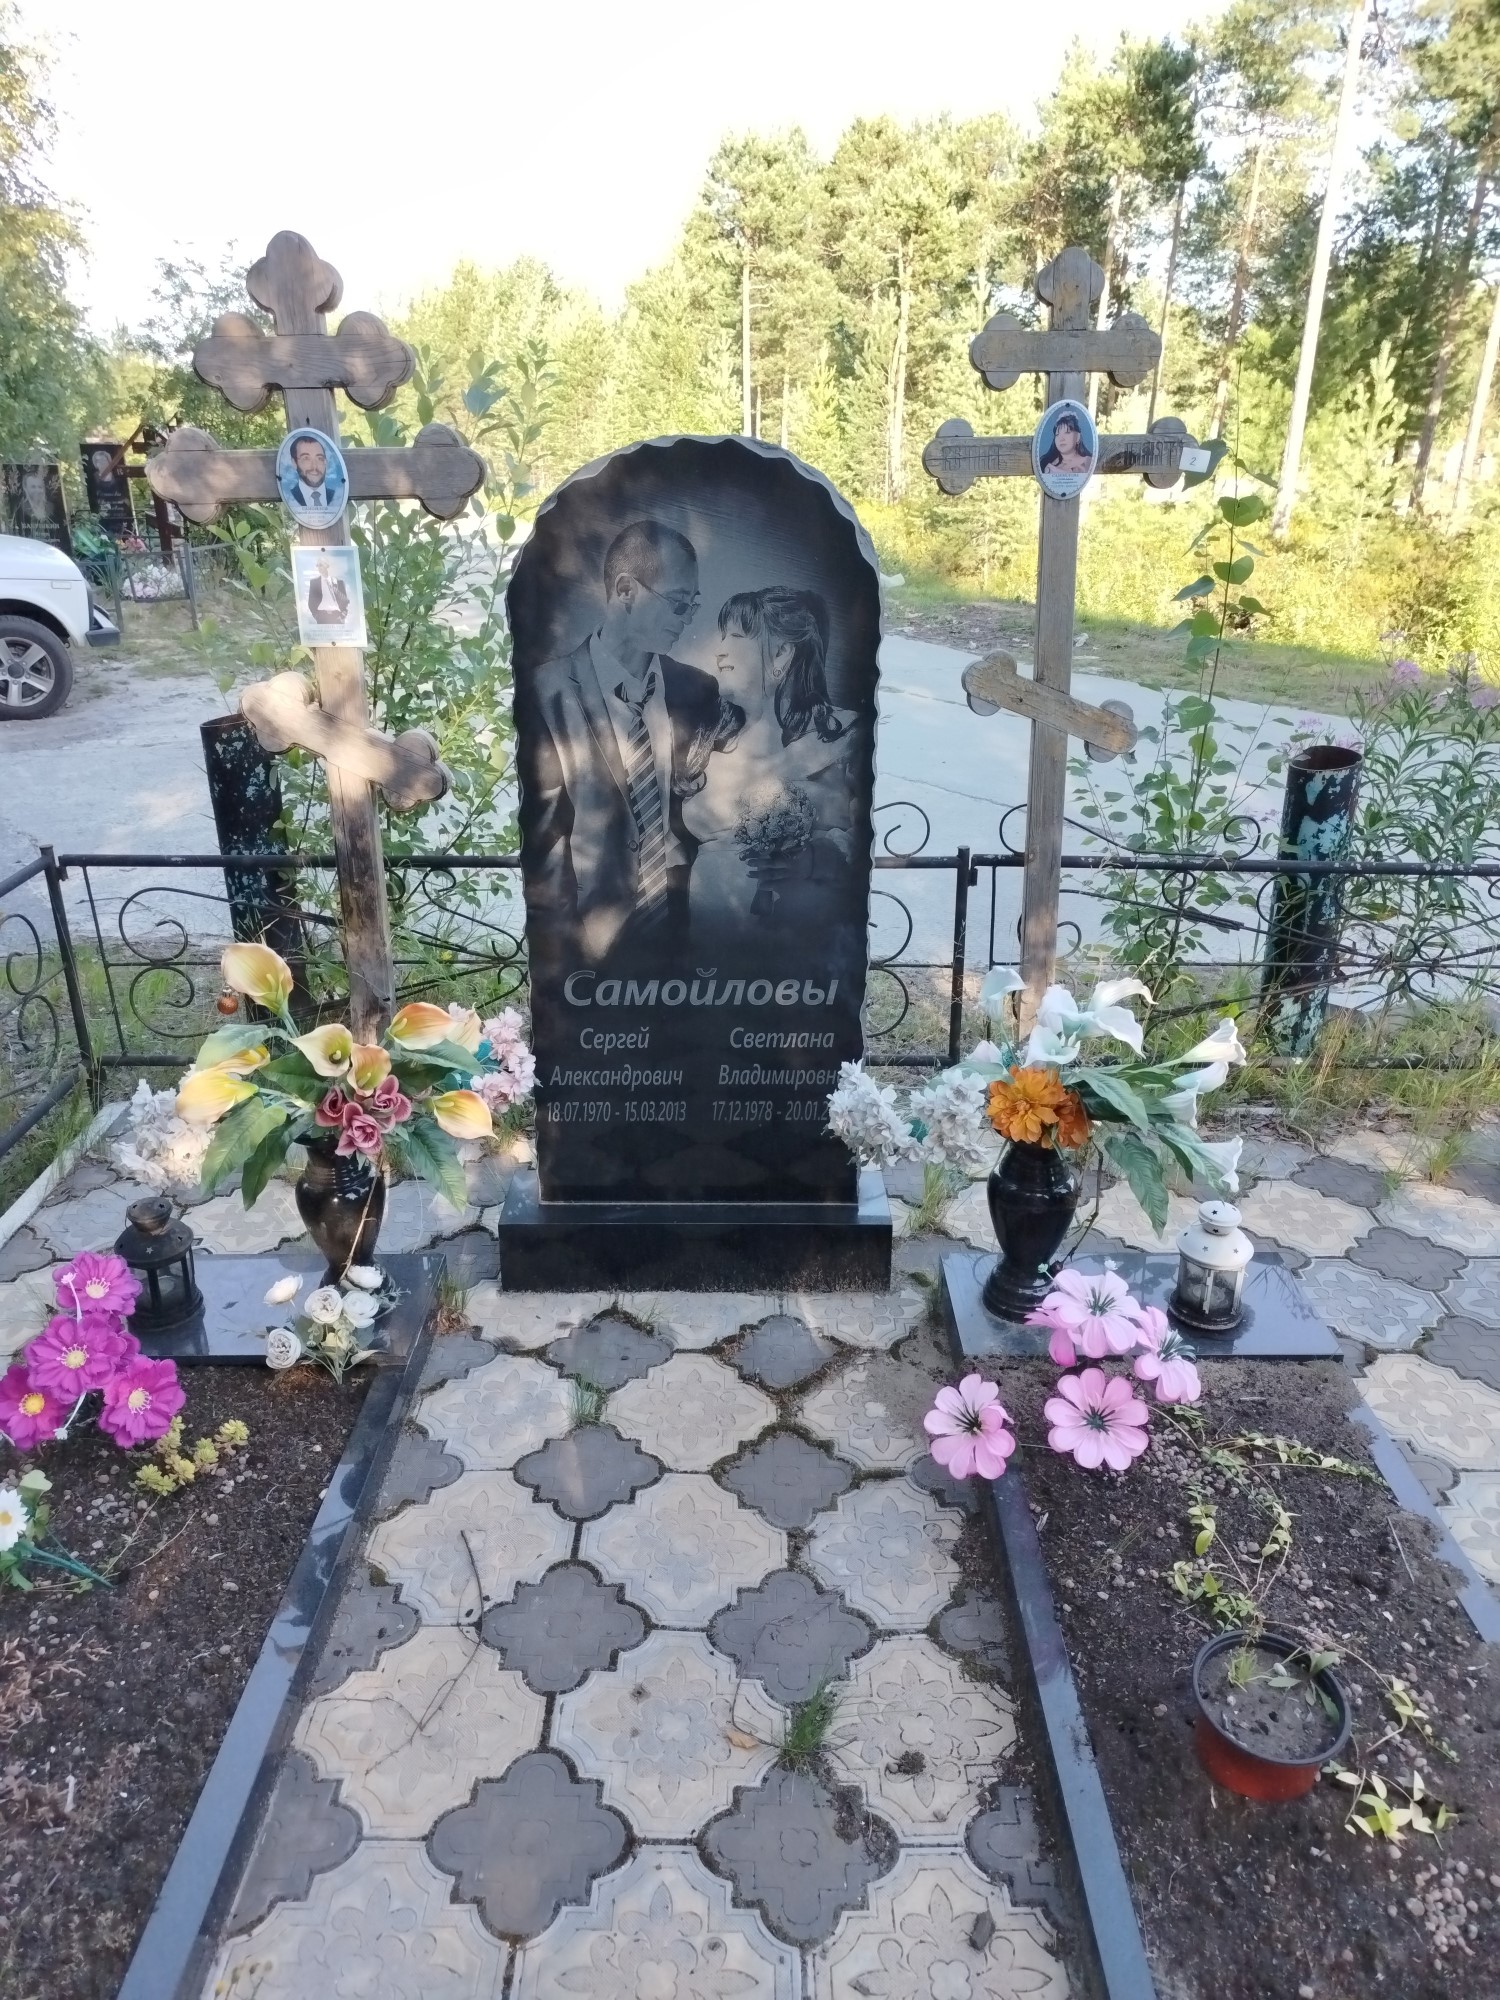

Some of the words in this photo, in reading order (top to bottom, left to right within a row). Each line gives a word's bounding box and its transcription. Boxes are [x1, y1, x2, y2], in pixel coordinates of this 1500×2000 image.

[1189, 456, 1197, 466] 2
[563, 967, 839, 1007] Самойловы
[579, 1026, 650, 1056] Сергей
[729, 1026, 835, 1049] Светлана
[549, 1063, 683, 1092] Александрович
[546, 1101, 611, 1122] 18.07.1970
[624, 1101, 687, 1122] 15.03.2013
[712, 1100, 774, 1122] 17.12.1978
[785, 1100, 830, 1121] 20.01.2
